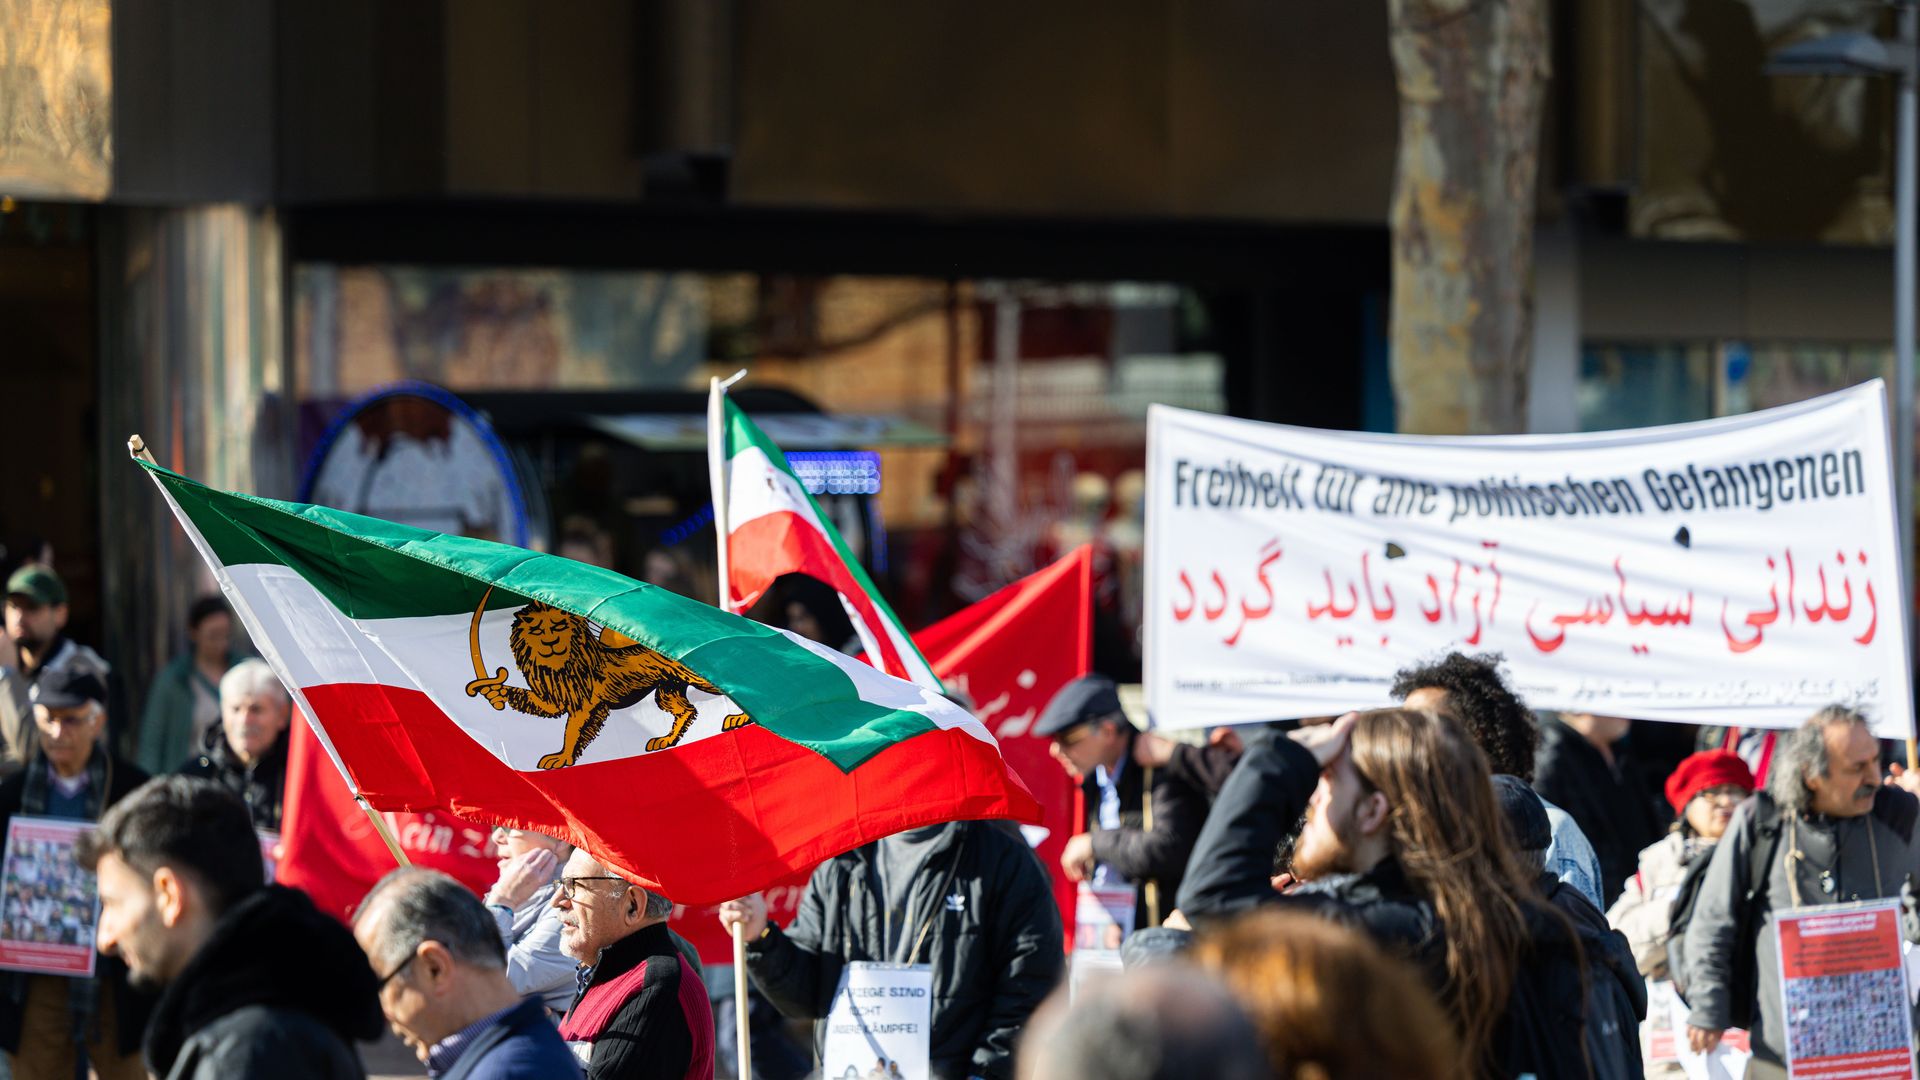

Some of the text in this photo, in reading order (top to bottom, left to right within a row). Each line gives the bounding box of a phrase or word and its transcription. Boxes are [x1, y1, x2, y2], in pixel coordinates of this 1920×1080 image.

[1174, 458, 1303, 510] Freiheit
[1446, 474, 1643, 522] politischen
[1643, 447, 1865, 512] Gefangenen
[1173, 537, 1878, 655] زندانی سیاسی آزاد باید گردد
[889, 986, 926, 998] SIND
